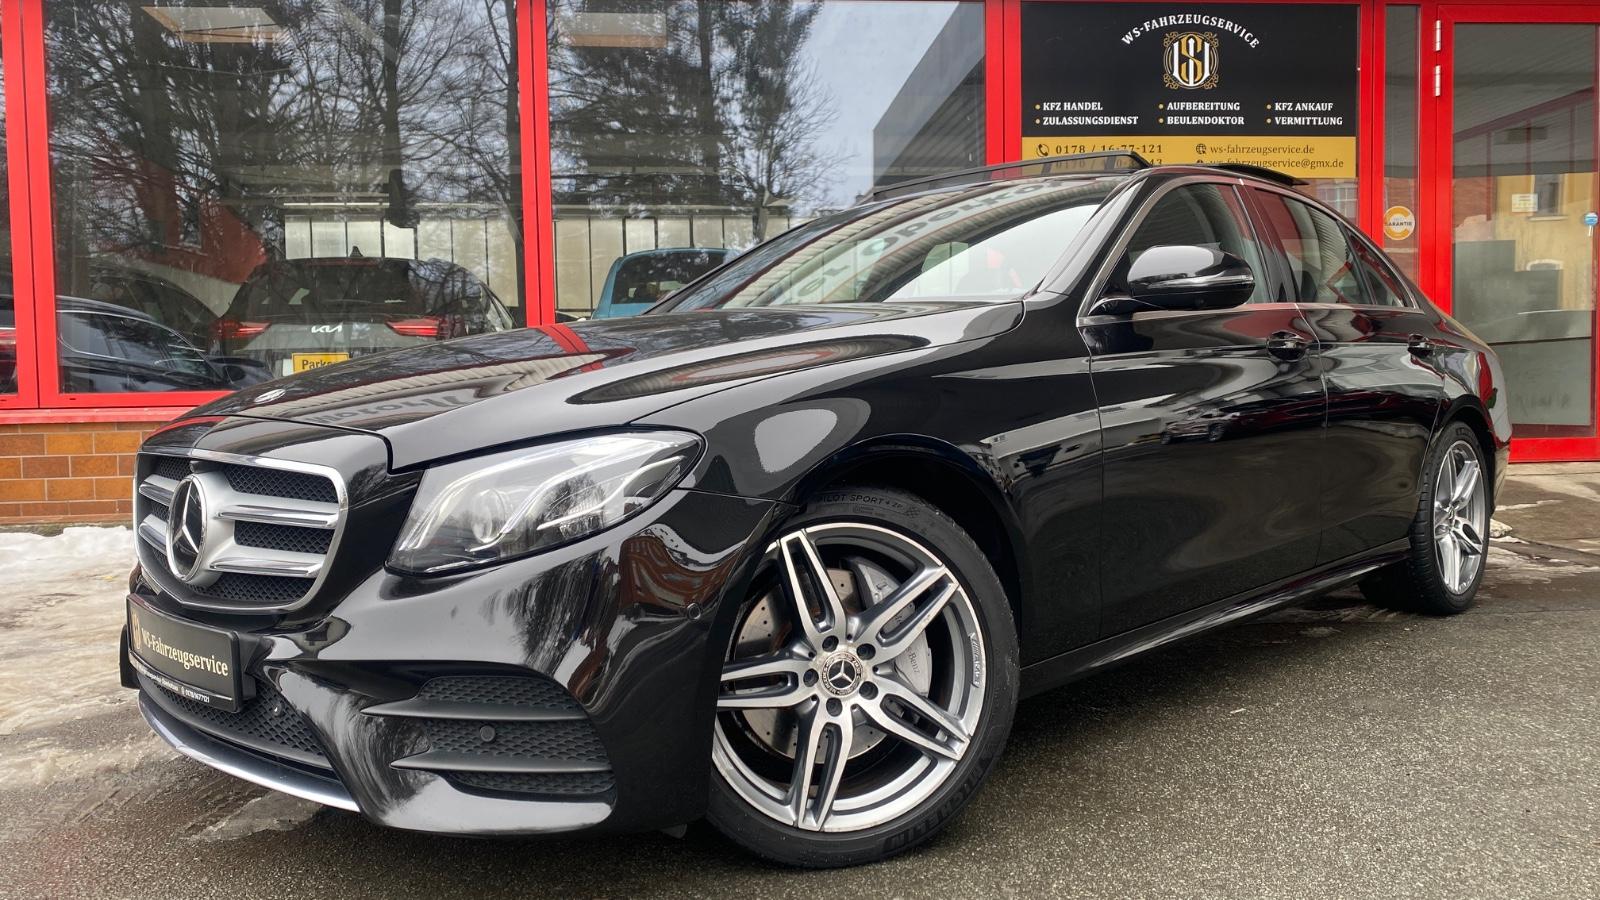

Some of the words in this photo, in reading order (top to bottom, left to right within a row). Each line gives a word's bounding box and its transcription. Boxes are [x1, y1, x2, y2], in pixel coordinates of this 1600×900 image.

[1121, 14, 1260, 49] WS-FAHRZEUGSERVICE
[1042, 102, 1062, 110] KFZ
[1064, 102, 1103, 110] HANDEL
[1167, 102, 1240, 111] AUFBEREITUNG
[1275, 102, 1293, 110] KFZ
[1295, 102, 1334, 111] ANKAUF
[1042, 116, 1138, 125] ZULASSUNGSDIENST
[1167, 116, 1244, 125] BEULENDOKTOR
[1275, 116, 1343, 126] VERMITTLUNG
[1056, 144, 1086, 154] 0178
[1210, 144, 1315, 156] ws-fahrzeugservice.de
[141, 627, 229, 677] WS-Fahrzeugservice
